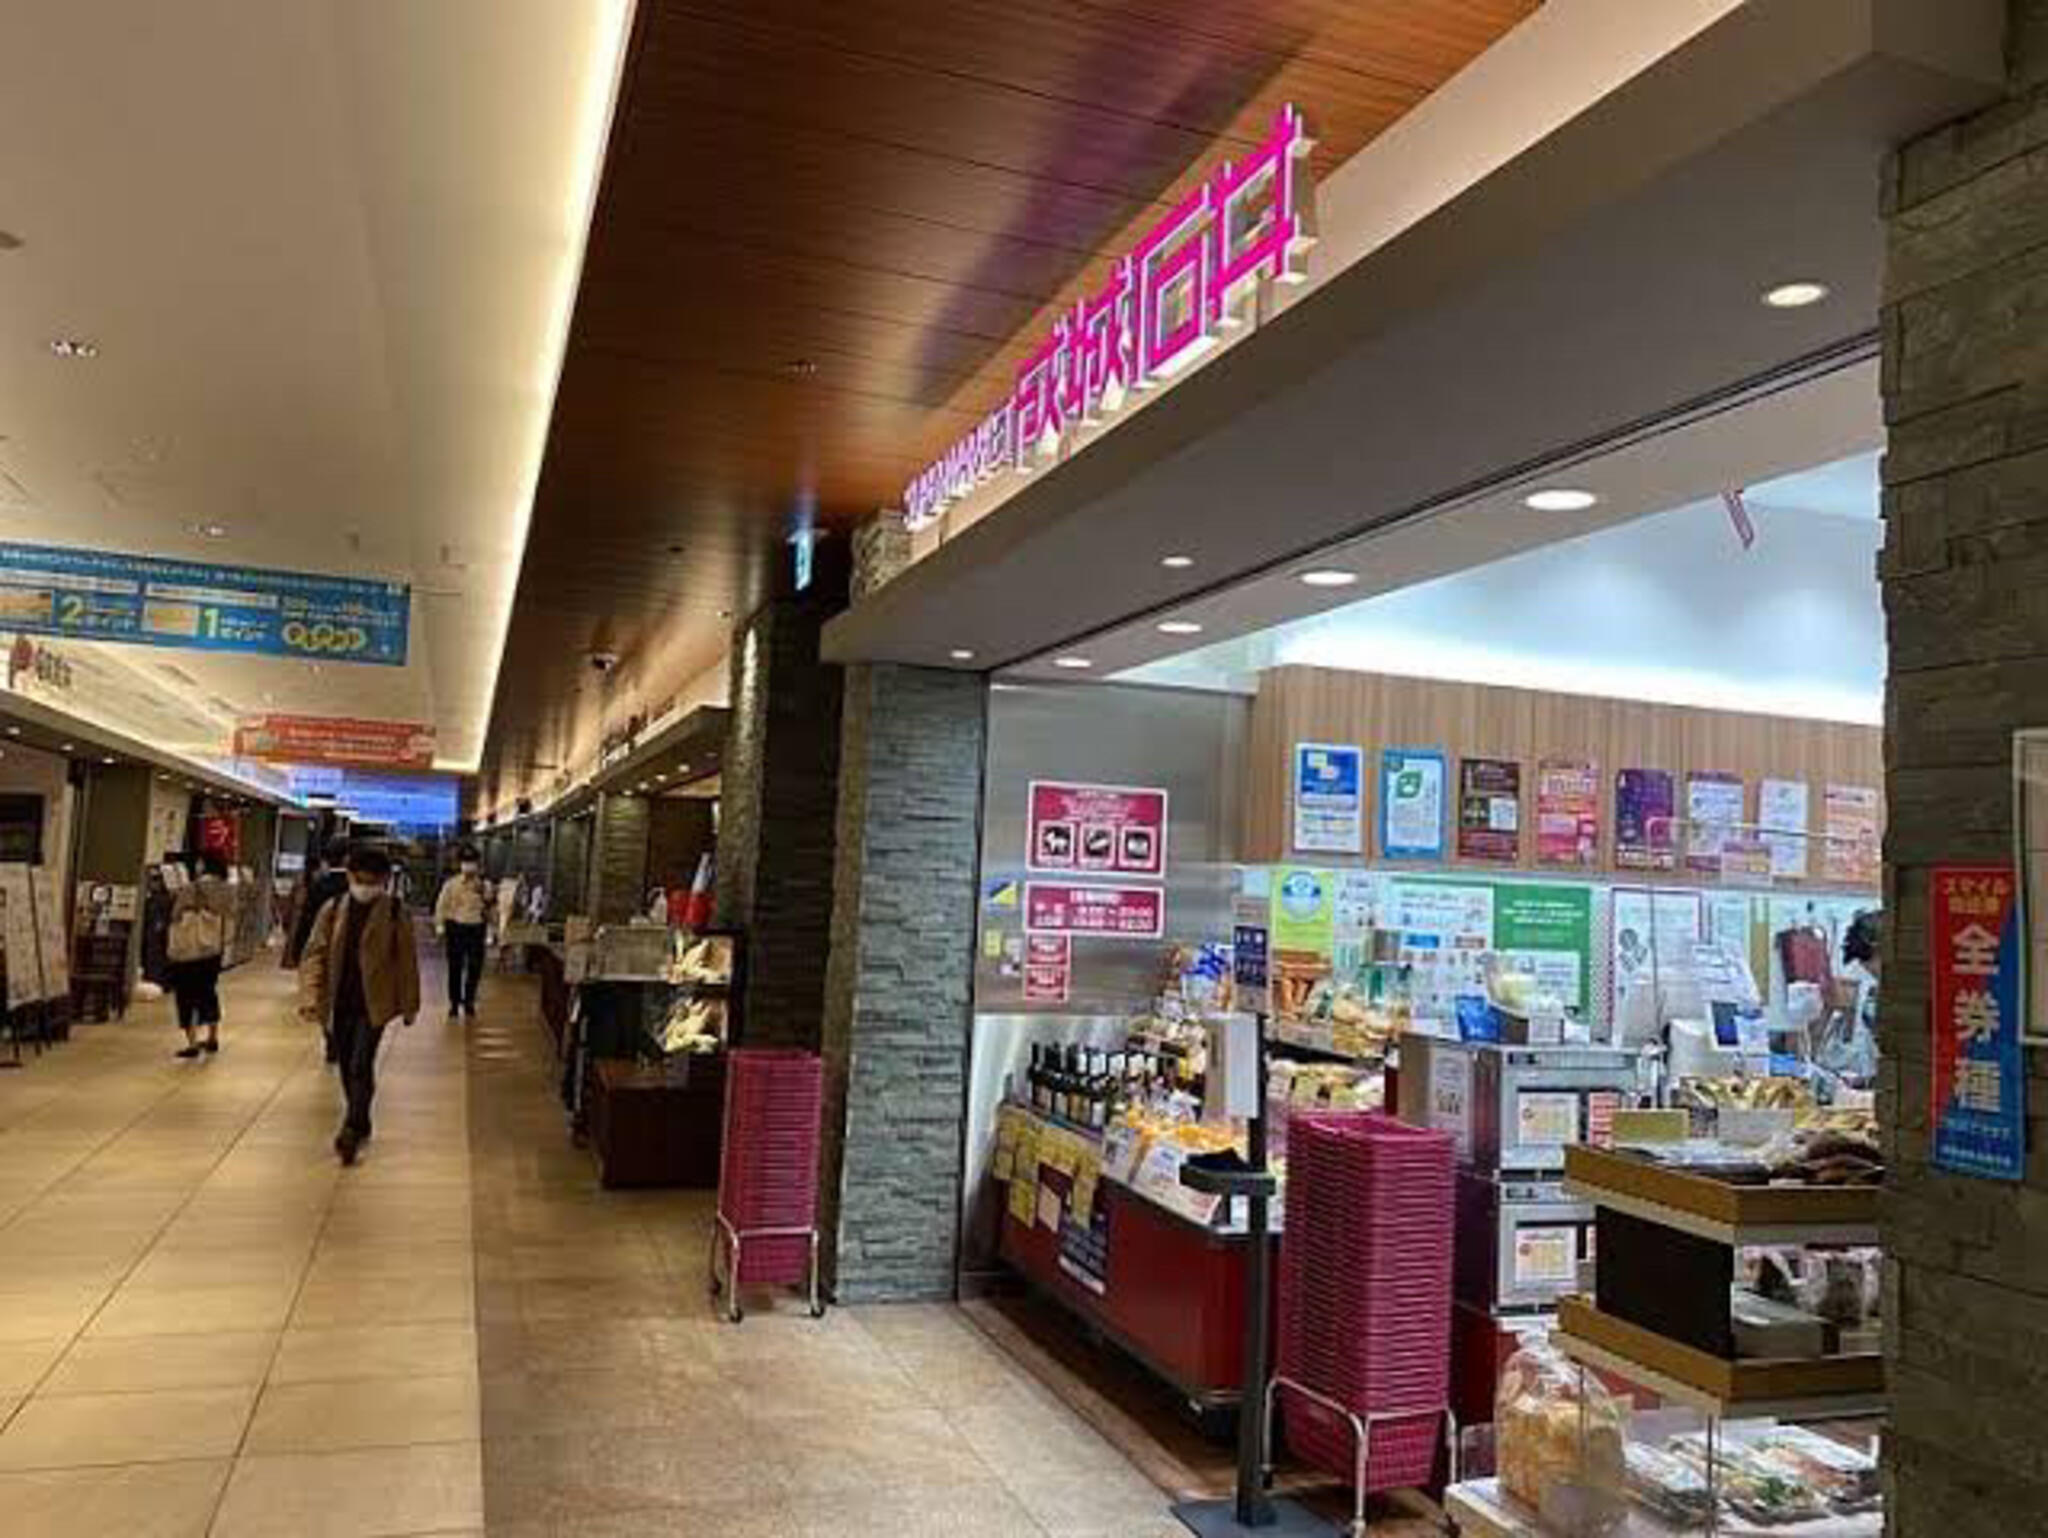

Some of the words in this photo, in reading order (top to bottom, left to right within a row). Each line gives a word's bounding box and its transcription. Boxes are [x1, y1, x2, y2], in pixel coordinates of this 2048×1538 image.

[1012, 102, 1304, 468] 成城石井
[1951, 922, 2002, 1114] 全券種
